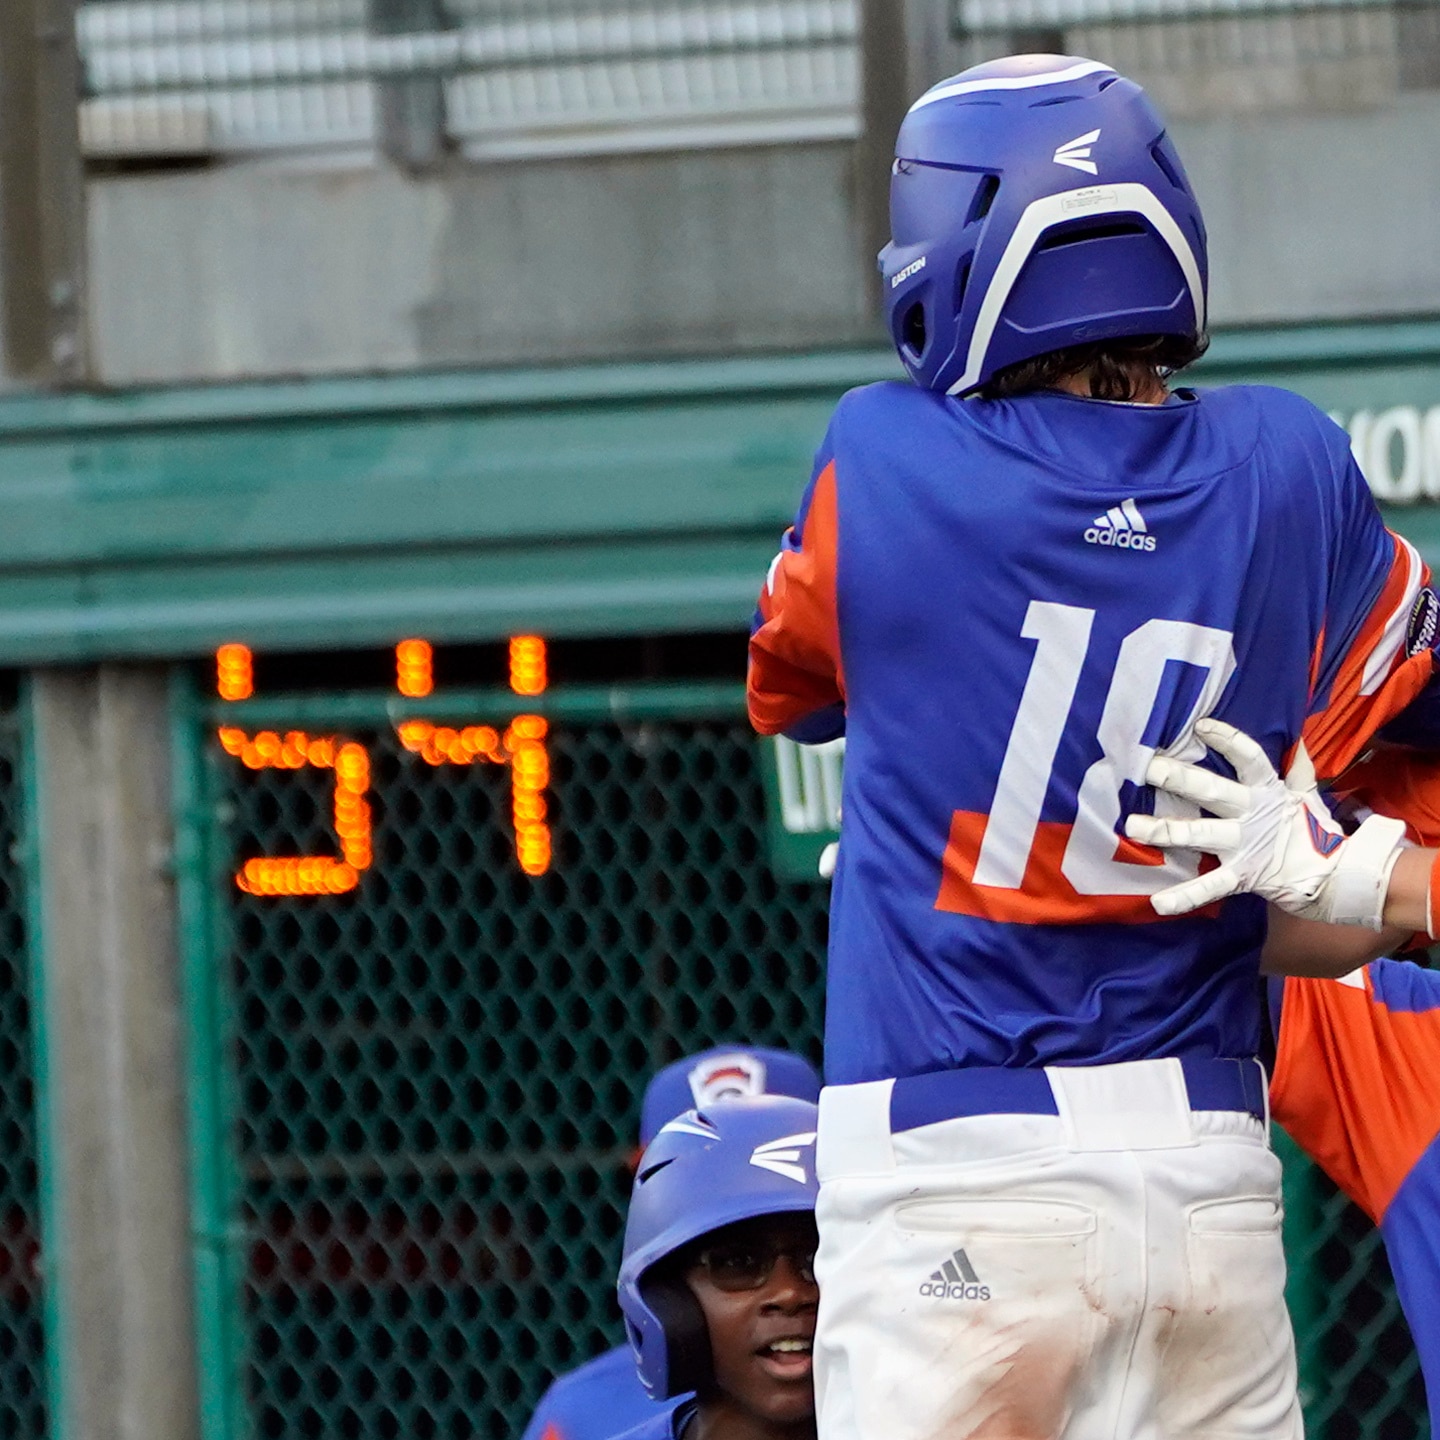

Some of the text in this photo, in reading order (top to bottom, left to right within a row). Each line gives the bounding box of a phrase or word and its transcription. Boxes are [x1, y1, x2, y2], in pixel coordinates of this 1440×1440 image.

[1083, 526, 1157, 552] adidas
[971, 599, 1238, 896] 18
[918, 1281, 991, 1301] adidas
